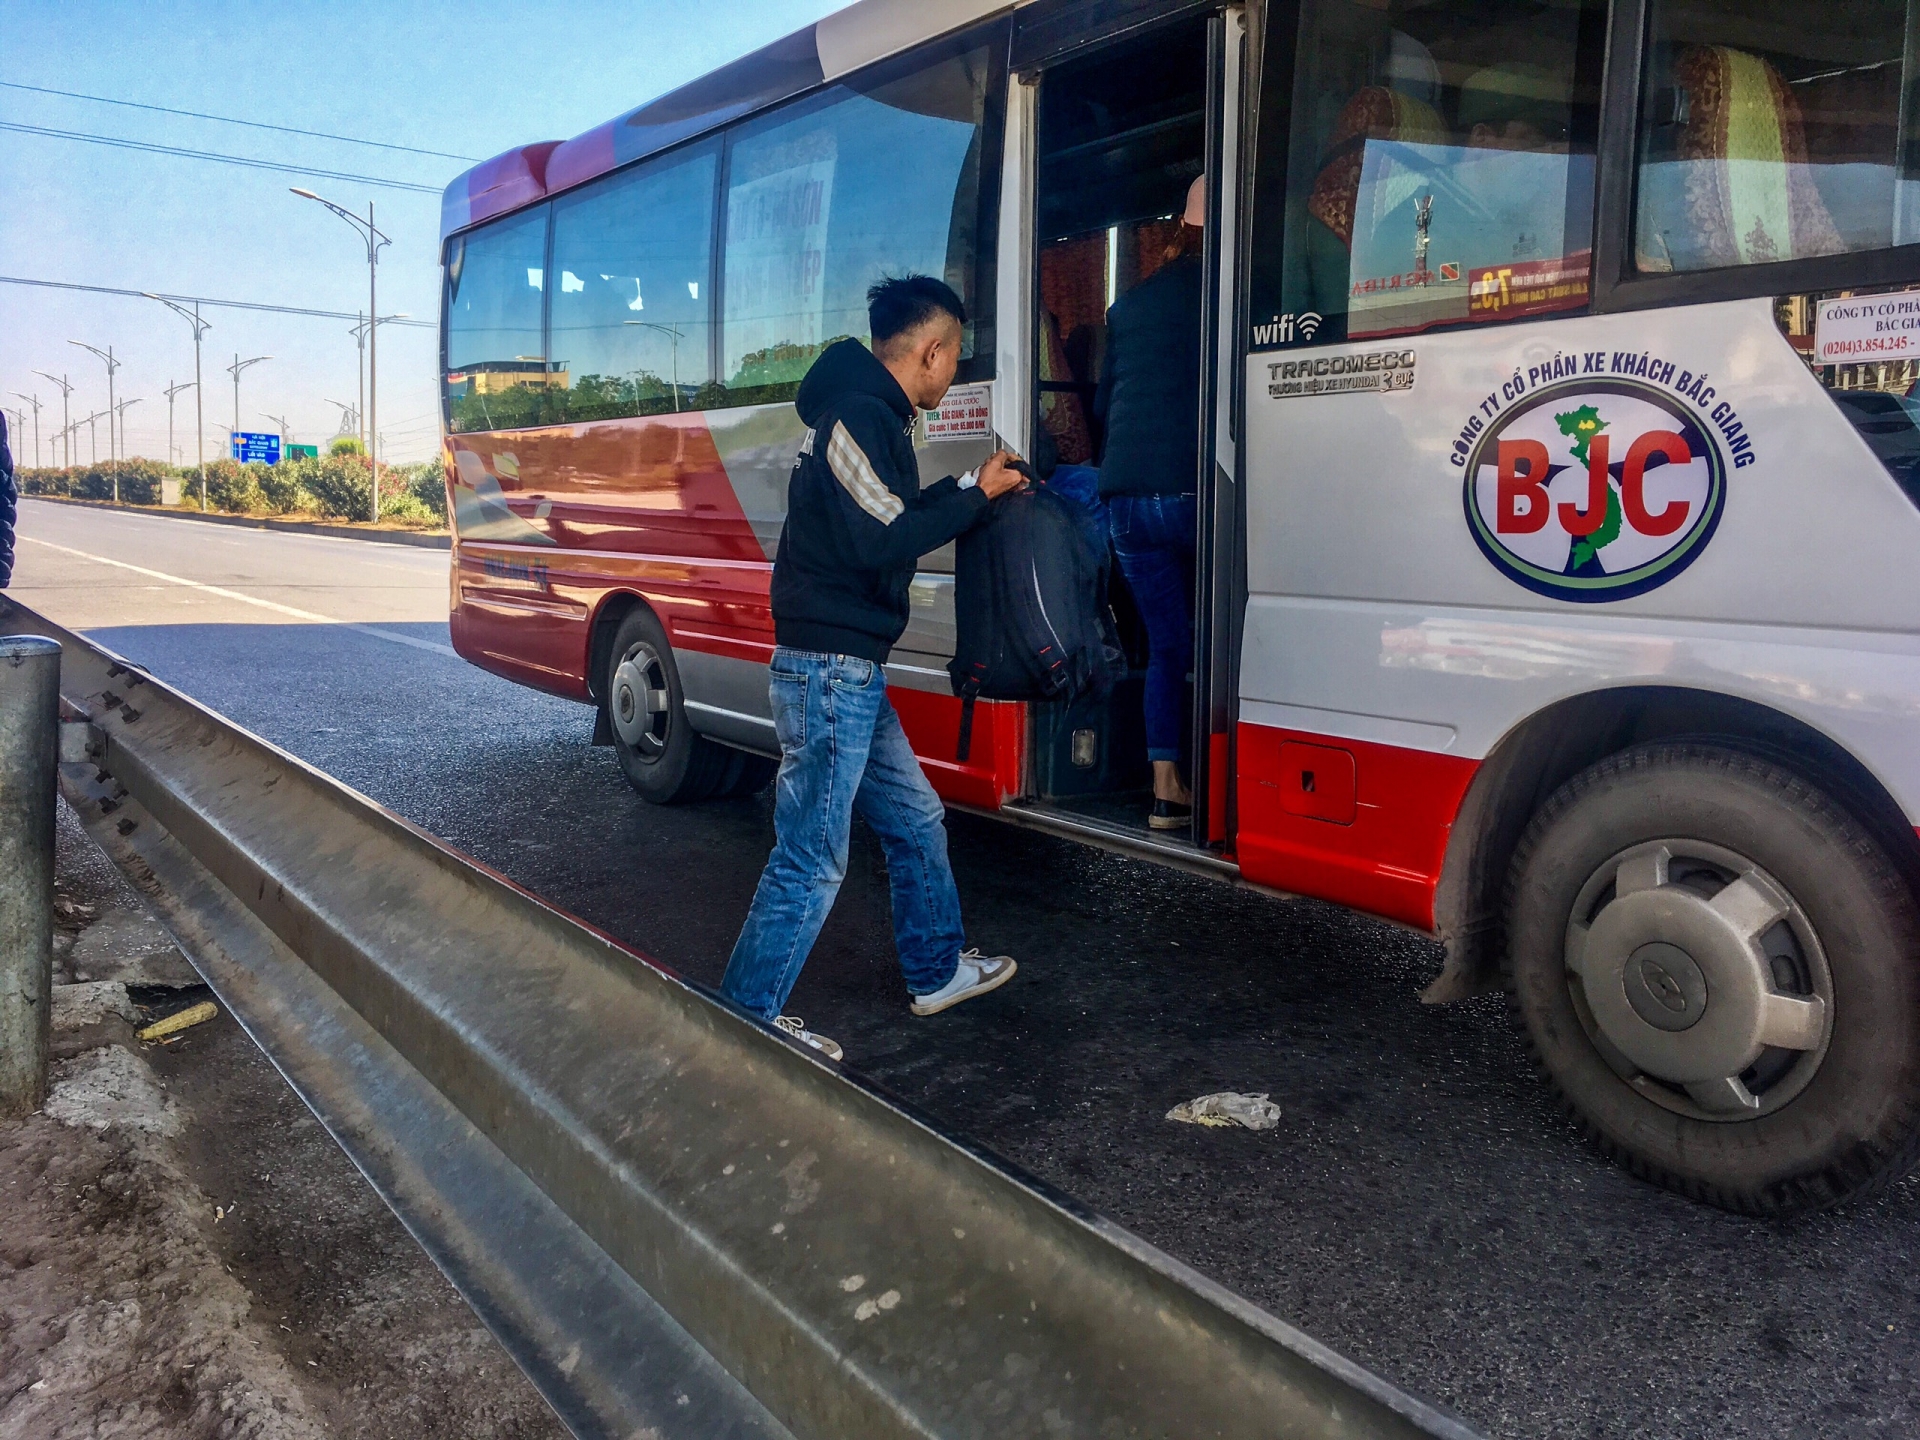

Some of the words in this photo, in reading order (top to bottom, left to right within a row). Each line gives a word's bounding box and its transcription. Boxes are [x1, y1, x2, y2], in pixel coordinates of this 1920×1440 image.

[1826, 305, 1859, 320] CÔNG
[1861, 305, 1876, 317] TY
[1253, 313, 1296, 345] wifi
[1823, 335, 1907, 358] (0204)3.854.245
[1267, 349, 1416, 381] TRACOMECO
[1338, 375, 1379, 390] HYUNDAI
[1450, 415, 1484, 467] CÔNG
[1480, 392, 1500, 418] TY
[1502, 367, 1525, 401] CỔ
[1582, 352, 1606, 373] XE
[1611, 351, 1676, 385] KHÁCH
[1674, 370, 1716, 407] BẮC
[1710, 401, 1756, 469] GIANG
[1496, 430, 1692, 537] BJC
